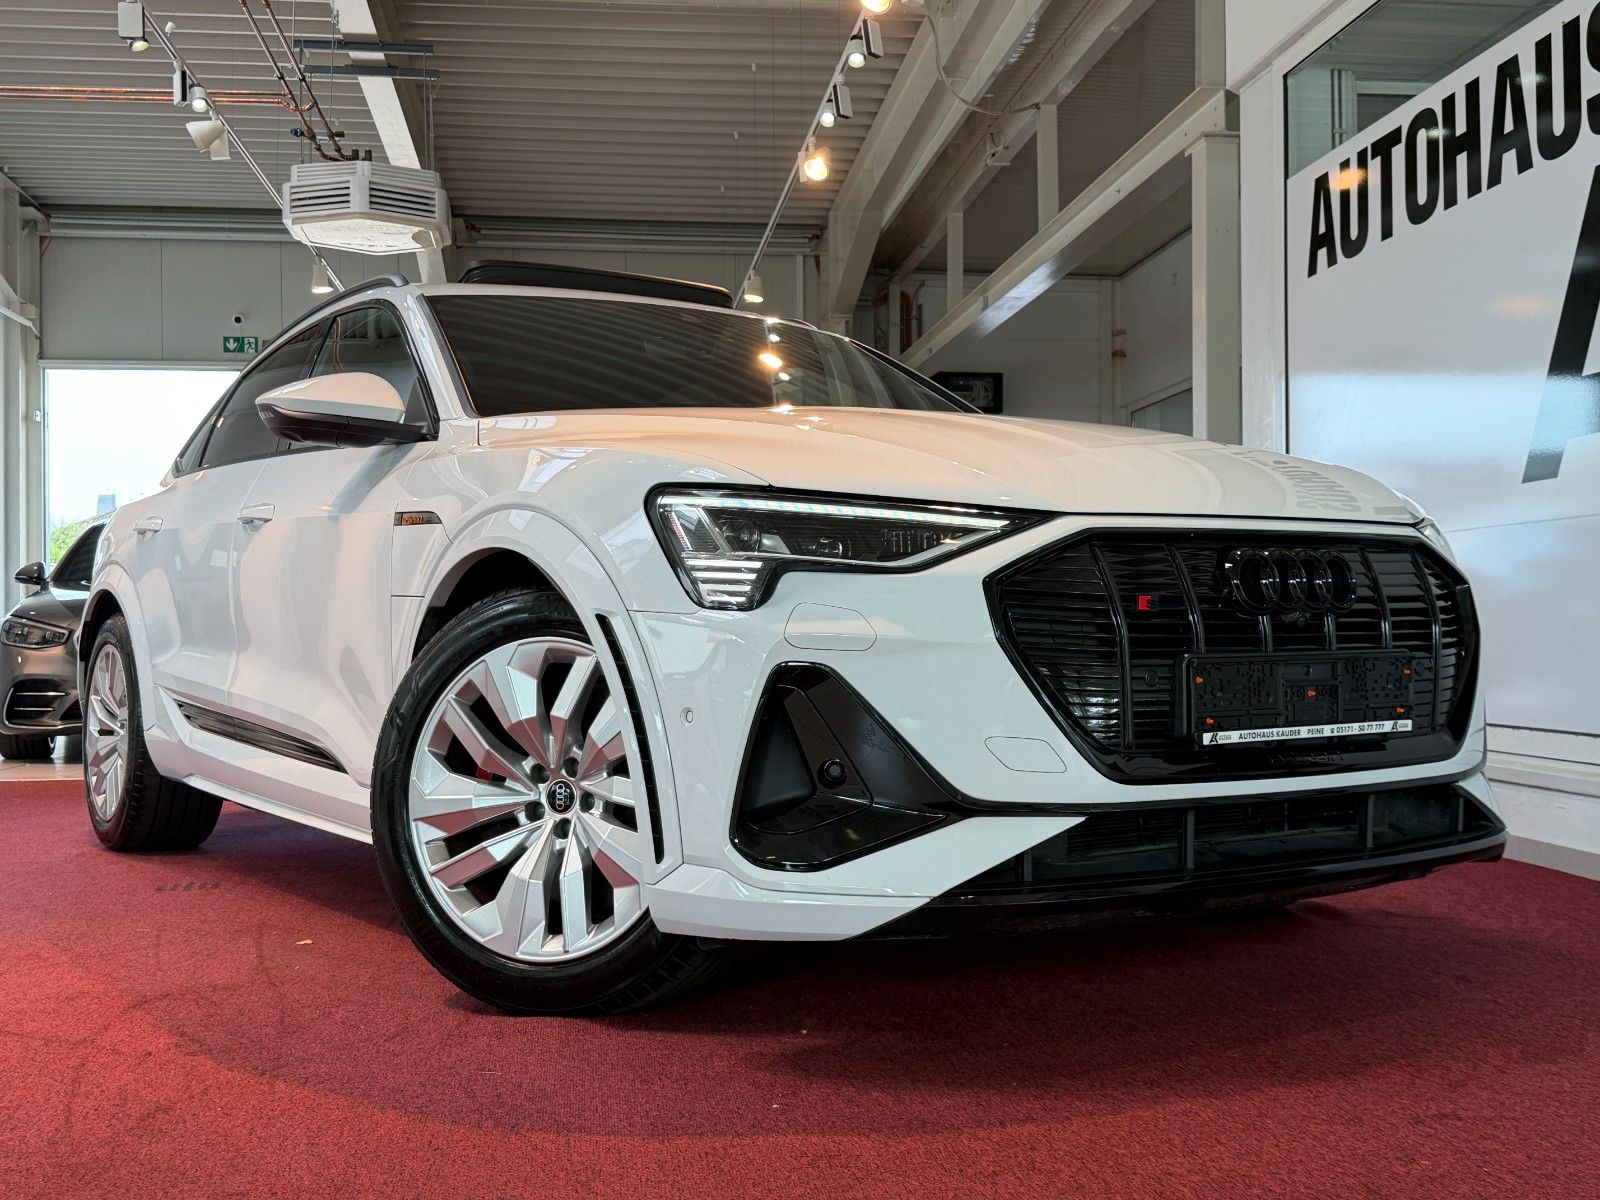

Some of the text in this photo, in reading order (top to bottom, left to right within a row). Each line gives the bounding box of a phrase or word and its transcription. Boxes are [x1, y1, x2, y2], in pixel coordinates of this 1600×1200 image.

[1239, 731, 1275, 740] AUTOHAUS
[1276, 729, 1301, 738] KAUDER
[1307, 727, 1324, 735] PEINE
[1336, 726, 1353, 734] 05171
[1375, 723, 1385, 731] 777
